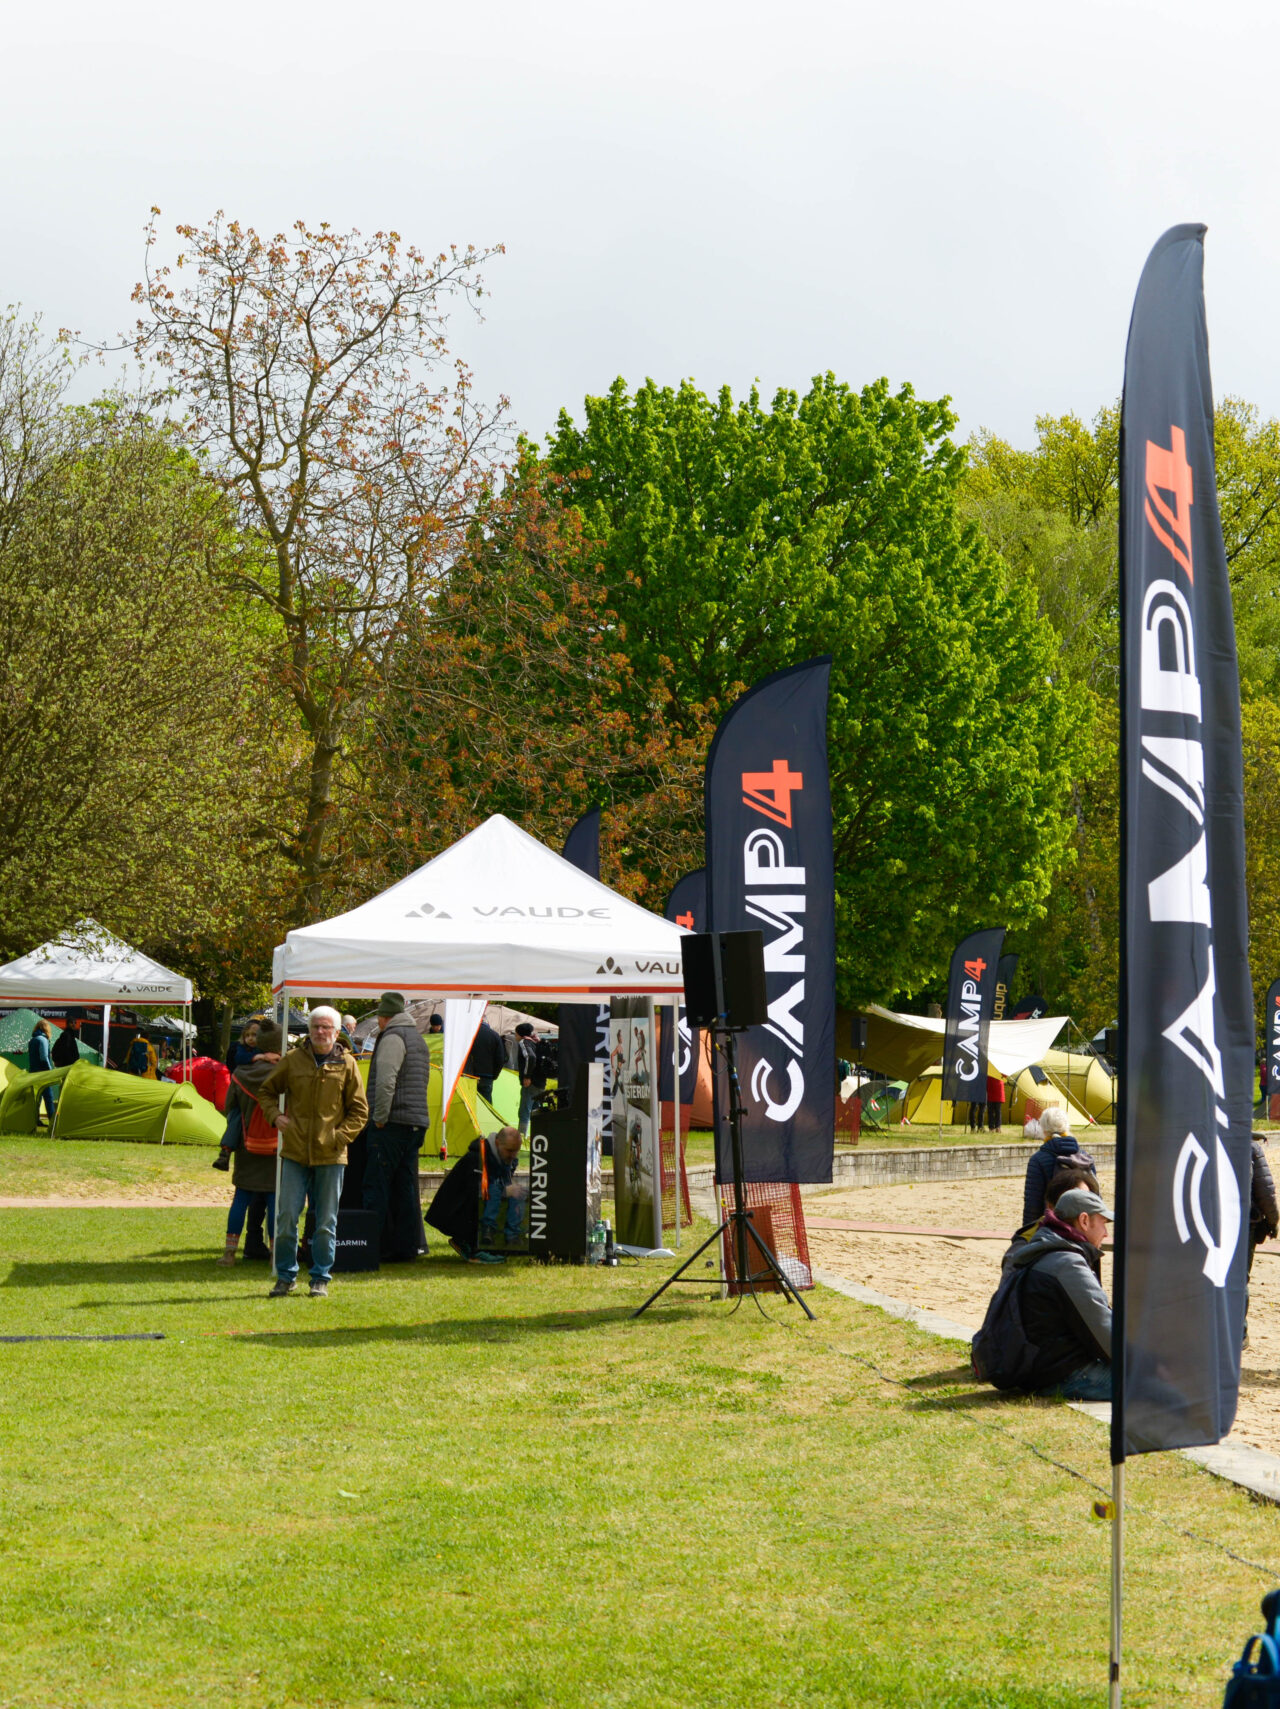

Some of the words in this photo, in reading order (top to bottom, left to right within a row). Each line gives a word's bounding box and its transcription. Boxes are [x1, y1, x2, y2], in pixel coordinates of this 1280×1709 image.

[472, 906, 612, 919] VAUDE
[635, 961, 683, 975] VAU
[136, 985, 173, 993] VAUDE
[955, 957, 987, 1081] CAMP4
[531, 1134, 548, 1240] GARMIN
